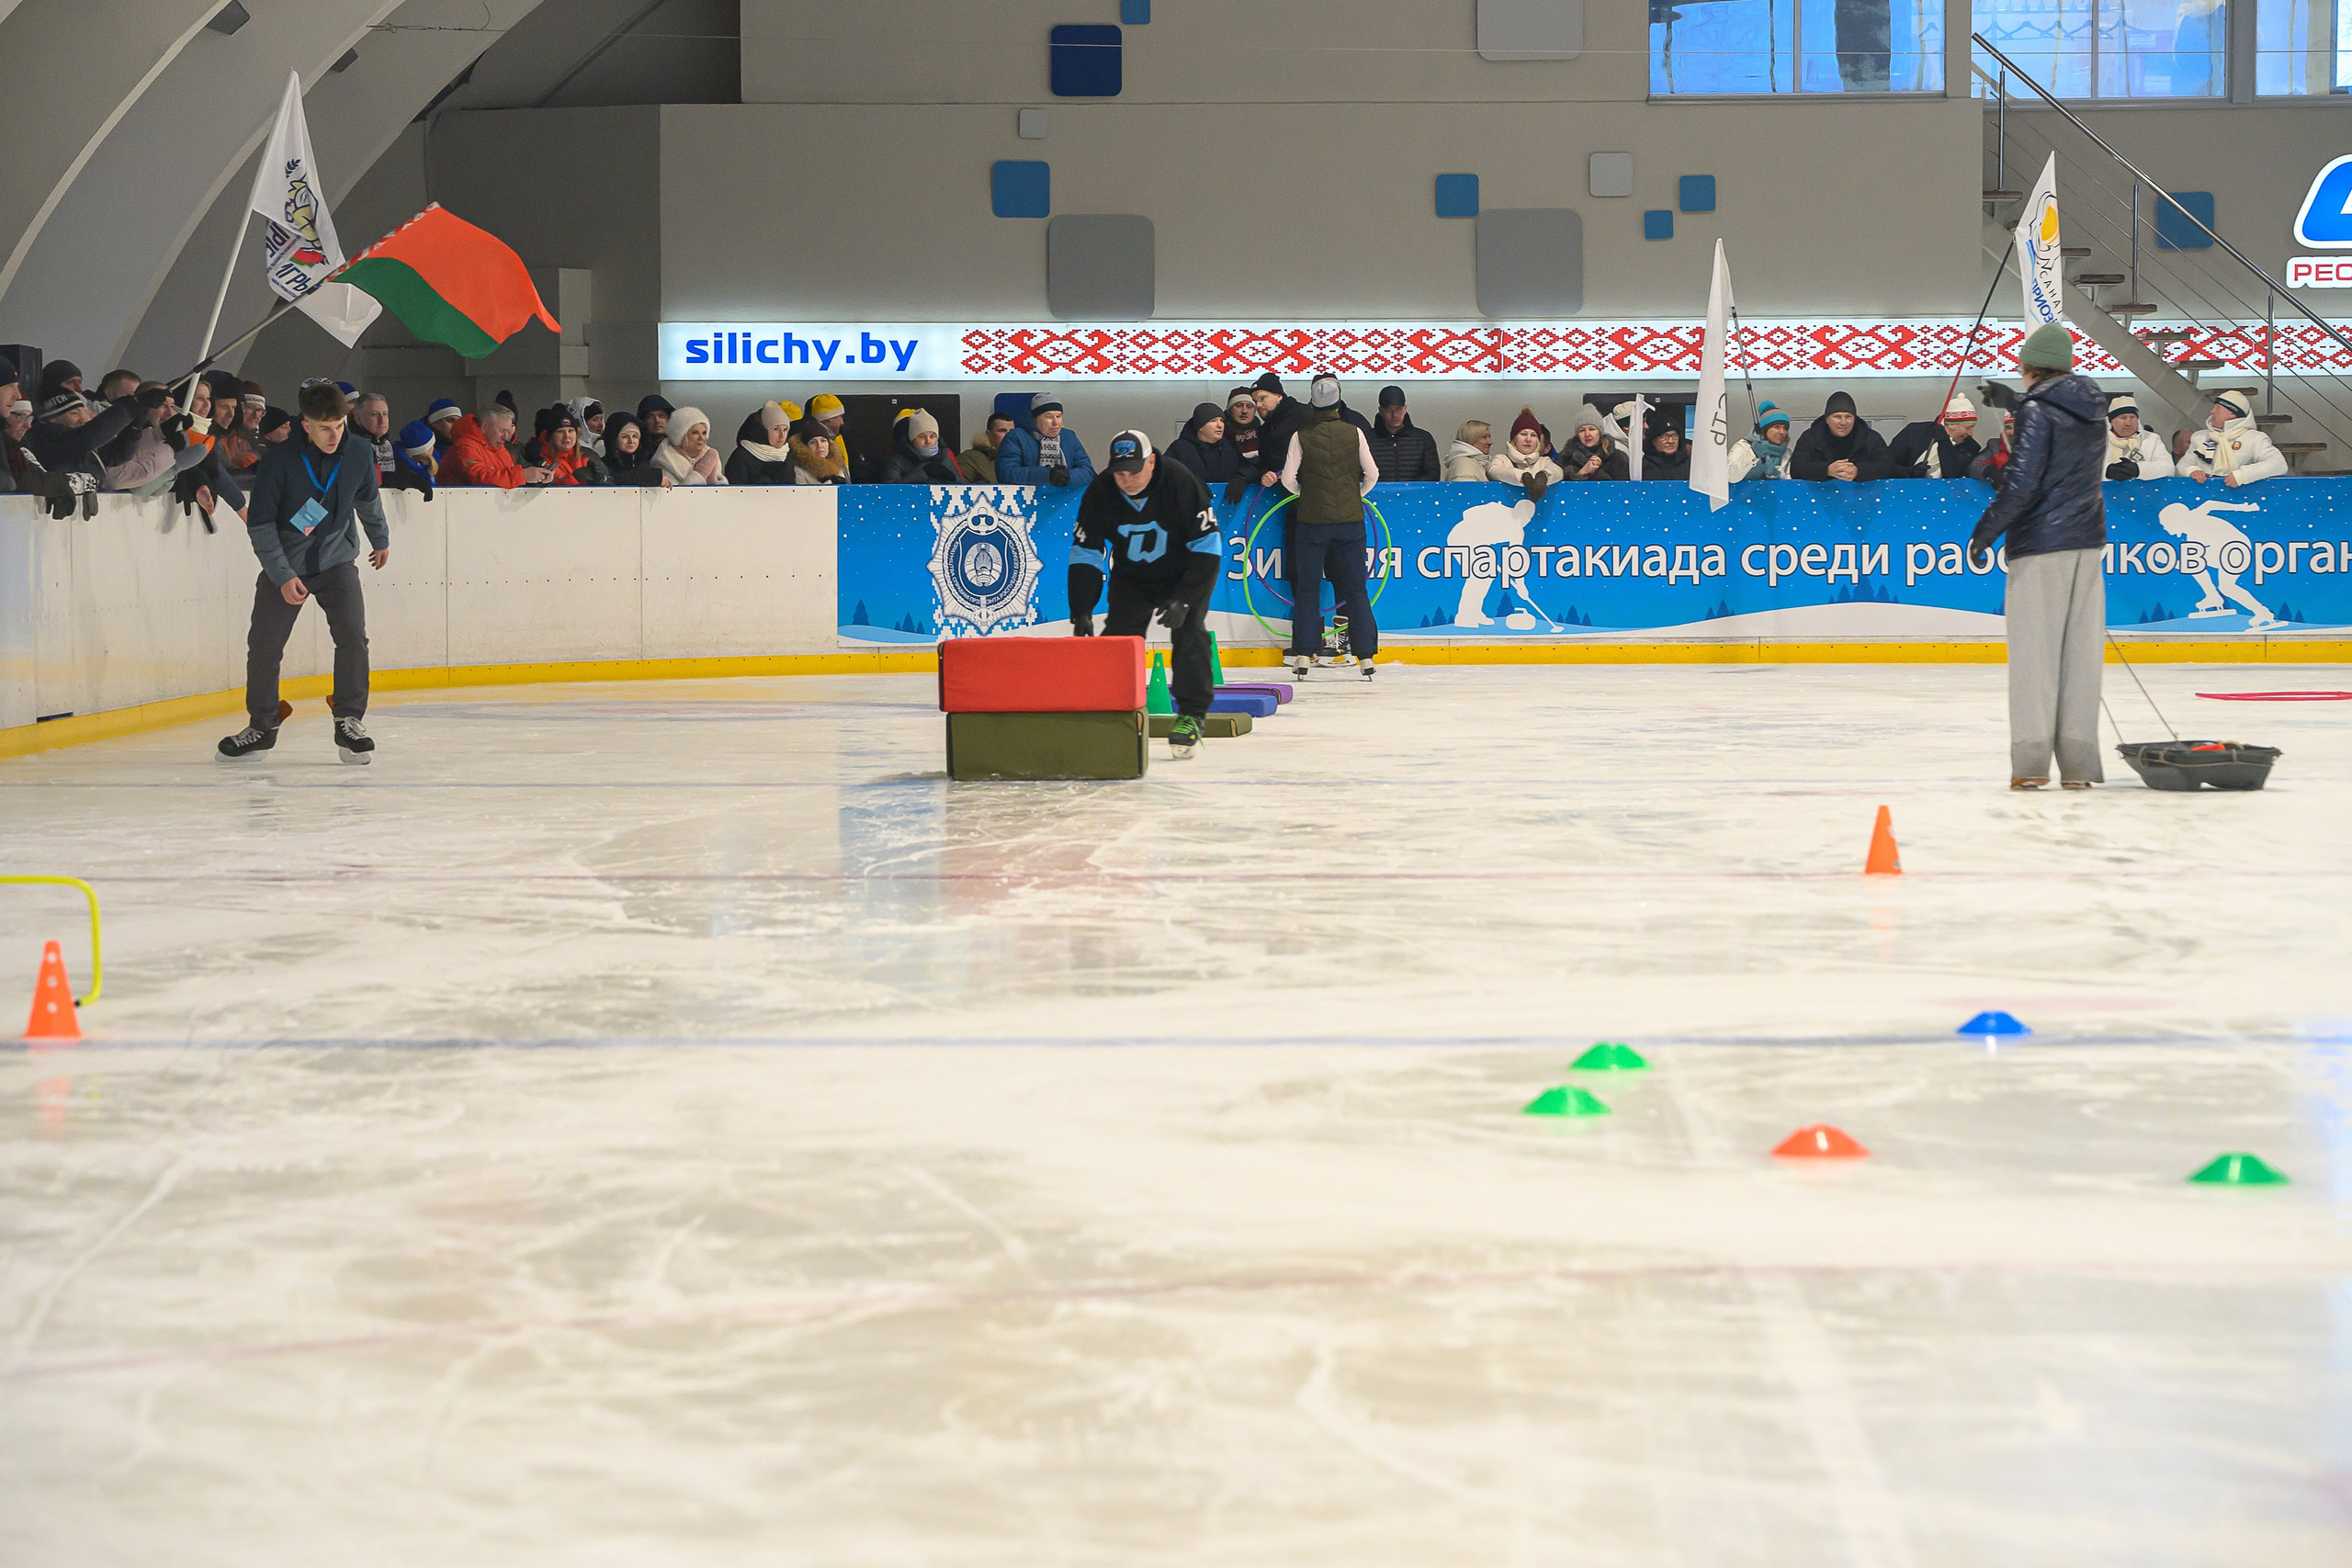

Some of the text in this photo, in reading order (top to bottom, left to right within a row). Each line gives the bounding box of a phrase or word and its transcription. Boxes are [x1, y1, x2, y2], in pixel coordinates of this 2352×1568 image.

[2031, 277, 2059, 323] ПРИОЗ
[685, 332, 919, 372] silichy.by
[1417, 543, 1727, 588] спартакиада
[1741, 542, 1889, 586] среди
